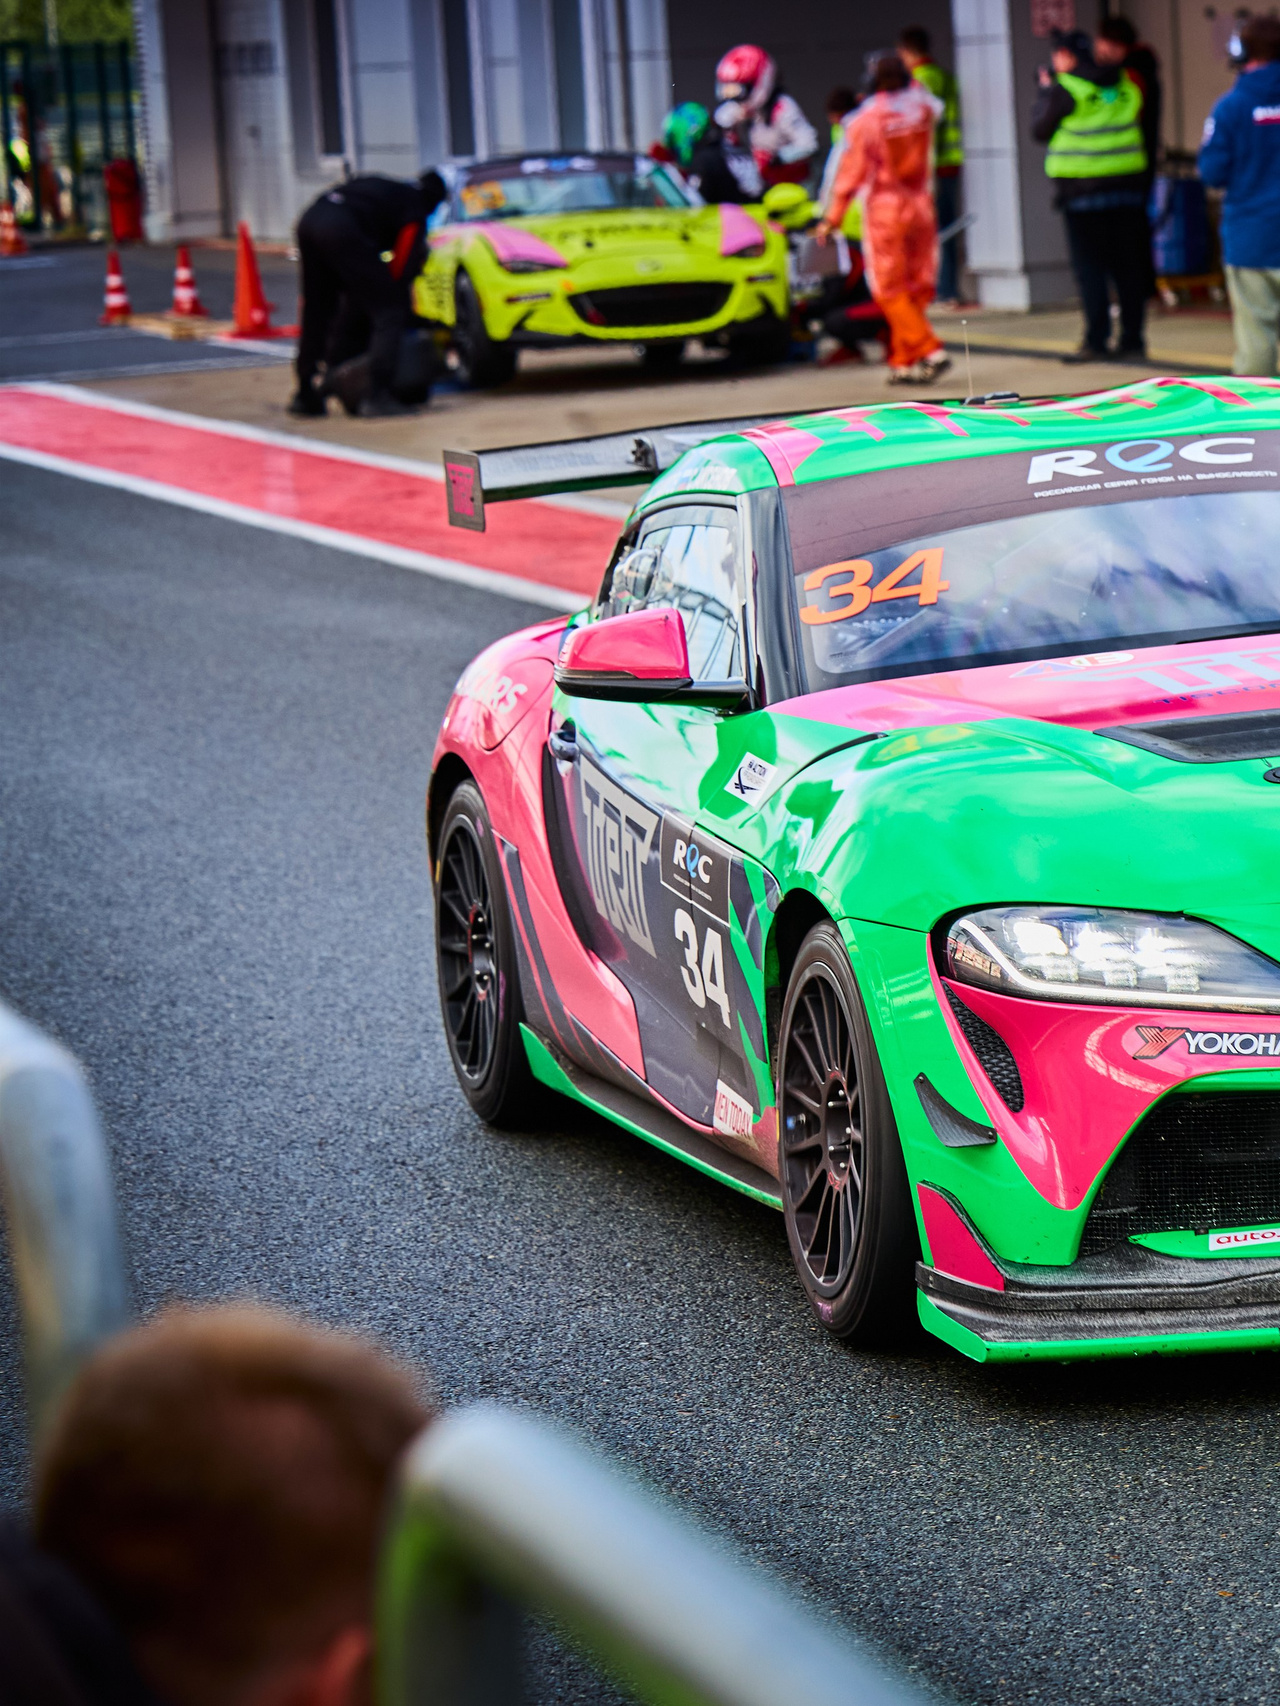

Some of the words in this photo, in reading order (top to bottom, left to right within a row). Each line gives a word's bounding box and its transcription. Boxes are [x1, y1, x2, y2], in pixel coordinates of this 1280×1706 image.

[1033, 483, 1102, 499] РОССИЙСКАЯ
[1104, 478, 1138, 489] СЕРИЯ
[1141, 475, 1175, 485] ГОНОК
[1177, 473, 1193, 481] НА
[1196, 470, 1278, 480] ВЫНОСЛИВОСТЬ
[800, 547, 950, 625] 34
[674, 907, 731, 1030] 34
